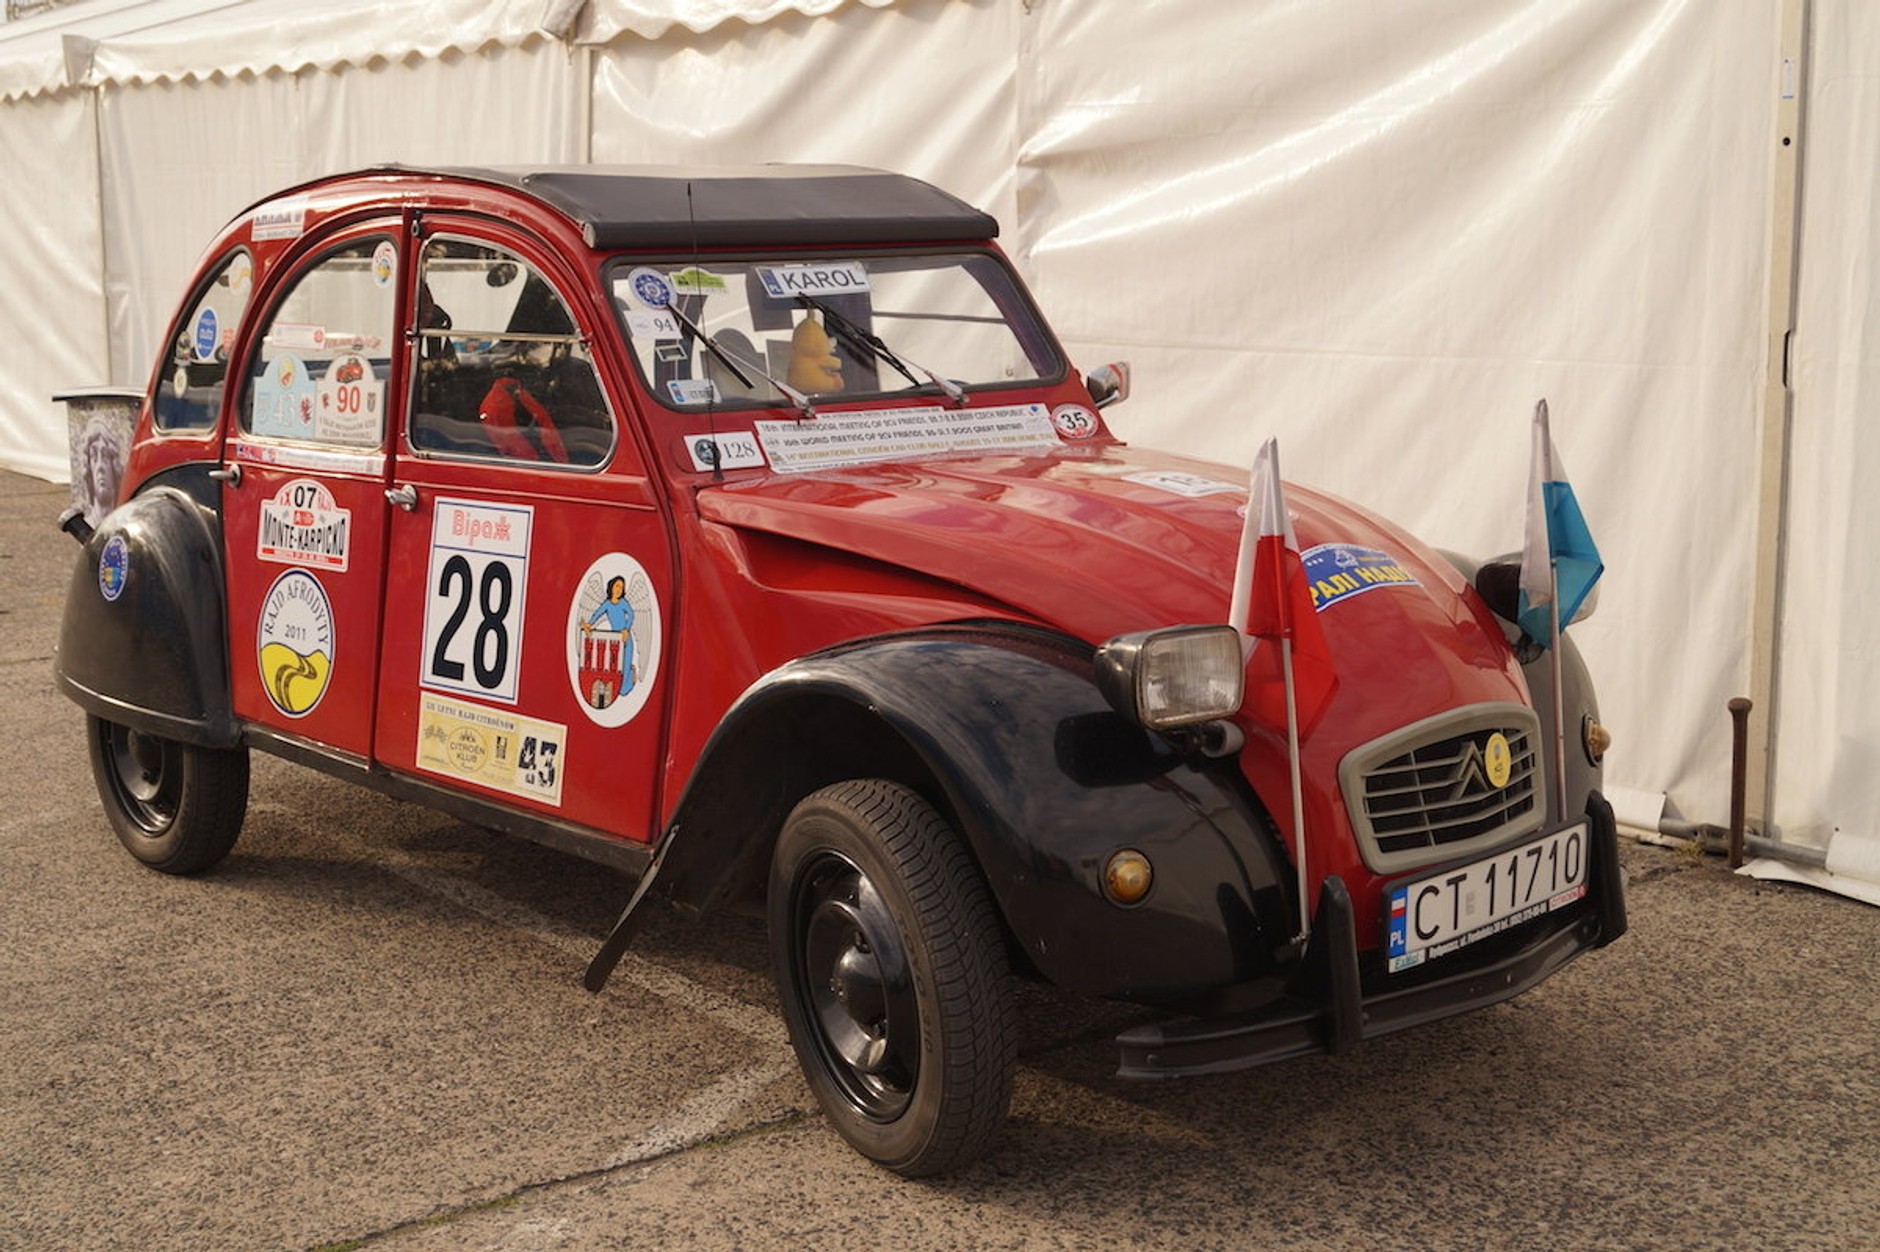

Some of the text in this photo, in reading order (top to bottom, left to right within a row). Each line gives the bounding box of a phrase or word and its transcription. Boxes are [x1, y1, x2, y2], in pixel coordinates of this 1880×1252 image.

[782, 268, 866, 290] KAROL
[653, 318, 674, 332] 94
[336, 386, 361, 413] 90
[839, 420, 870, 431] MEETING
[975, 411, 994, 421] CZECH
[1061, 411, 1089, 431] 35
[801, 436, 830, 446] WORLD
[831, 433, 863, 444] MEETING
[973, 424, 995, 434] GREAT
[722, 442, 755, 459] 128
[294, 485, 317, 508] 07
[264, 579, 329, 645] RAJD AFRODYTY
[432, 555, 512, 690] 28
[284, 624, 307, 641] 2011
[1414, 872, 1468, 941] CT
[1485, 832, 1581, 917] 11710
[1390, 931, 1405, 948] PL
